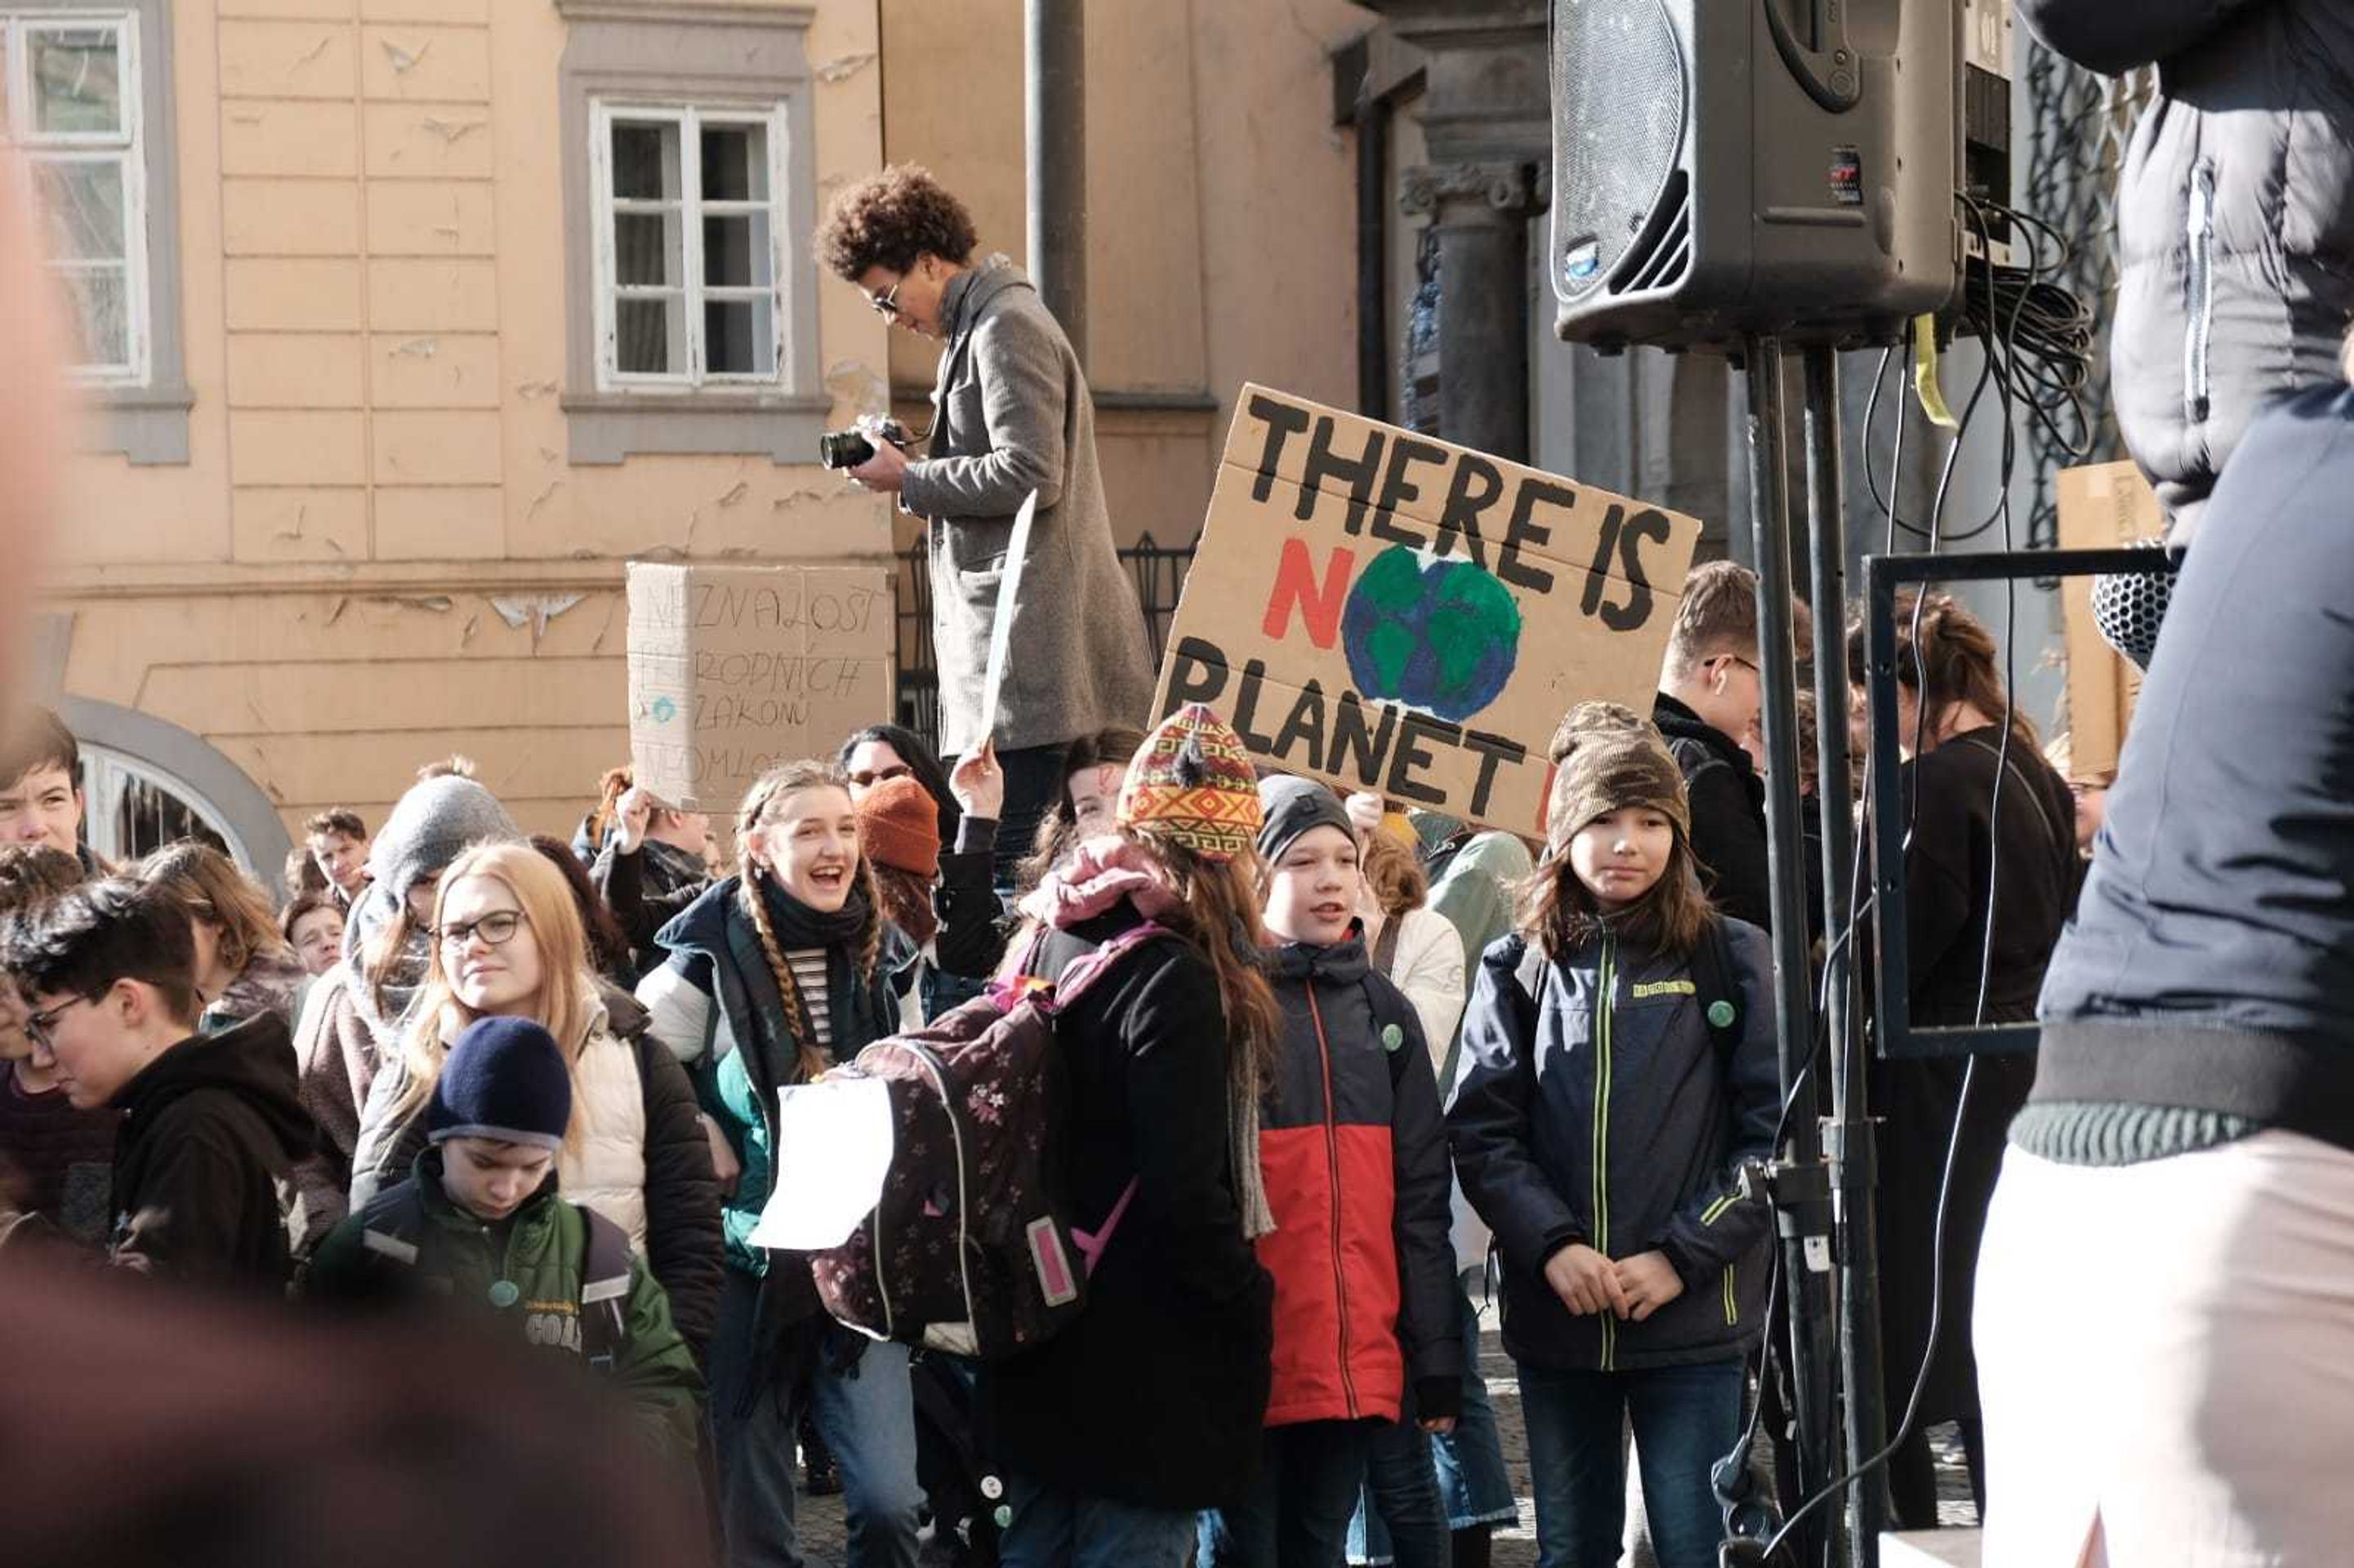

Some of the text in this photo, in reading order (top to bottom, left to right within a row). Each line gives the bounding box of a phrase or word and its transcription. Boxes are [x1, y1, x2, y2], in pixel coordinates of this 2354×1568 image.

[1247, 394, 1670, 631] THERE IS
[1163, 635, 1527, 817] PLANET
